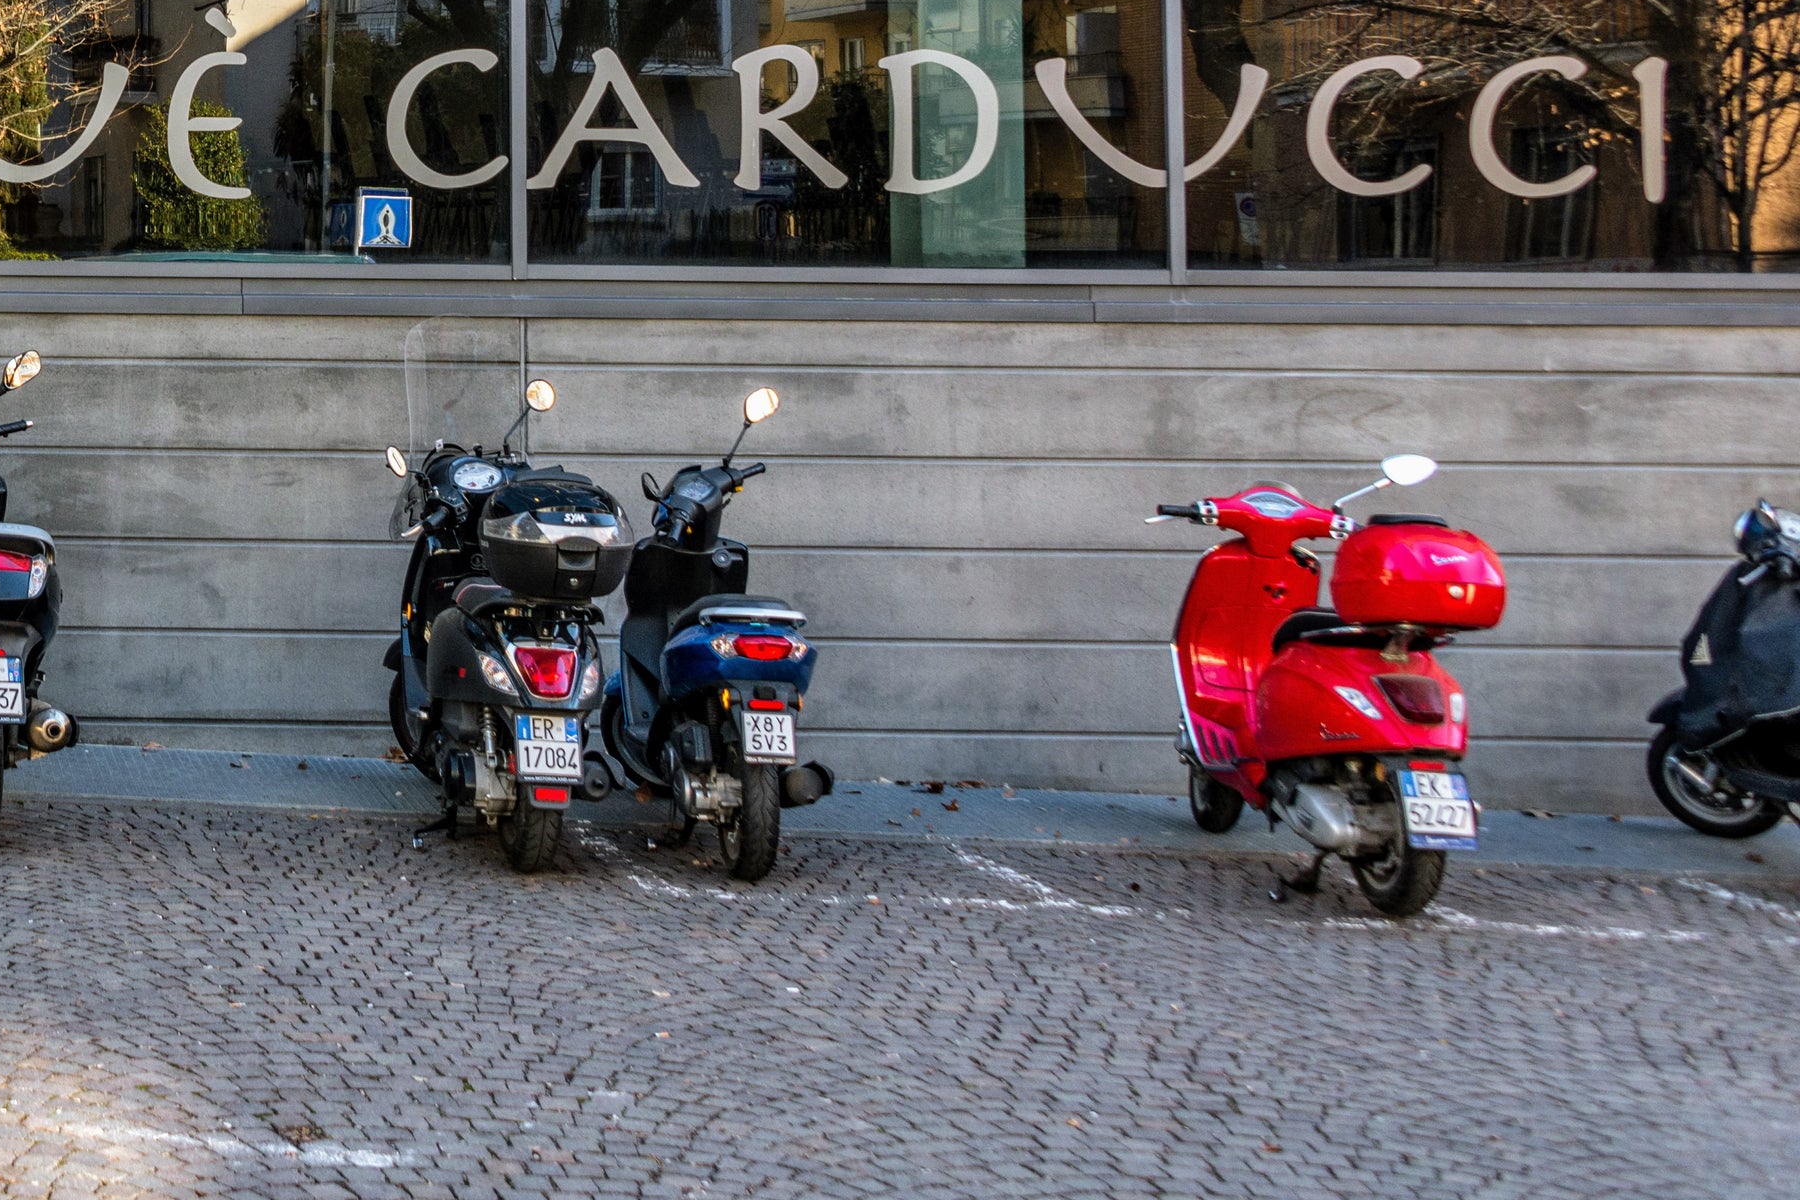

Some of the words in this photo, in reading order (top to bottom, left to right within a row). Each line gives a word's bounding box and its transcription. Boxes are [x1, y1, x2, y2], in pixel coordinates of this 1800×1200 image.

[563, 513, 588, 524] SYM
[532, 718, 554, 740] ER
[751, 715, 785, 733] X8Y
[752, 734, 787, 751] 5V3
[524, 746, 578, 769] 17084
[1416, 773, 1441, 797] EK
[1410, 802, 1467, 828] 52427
